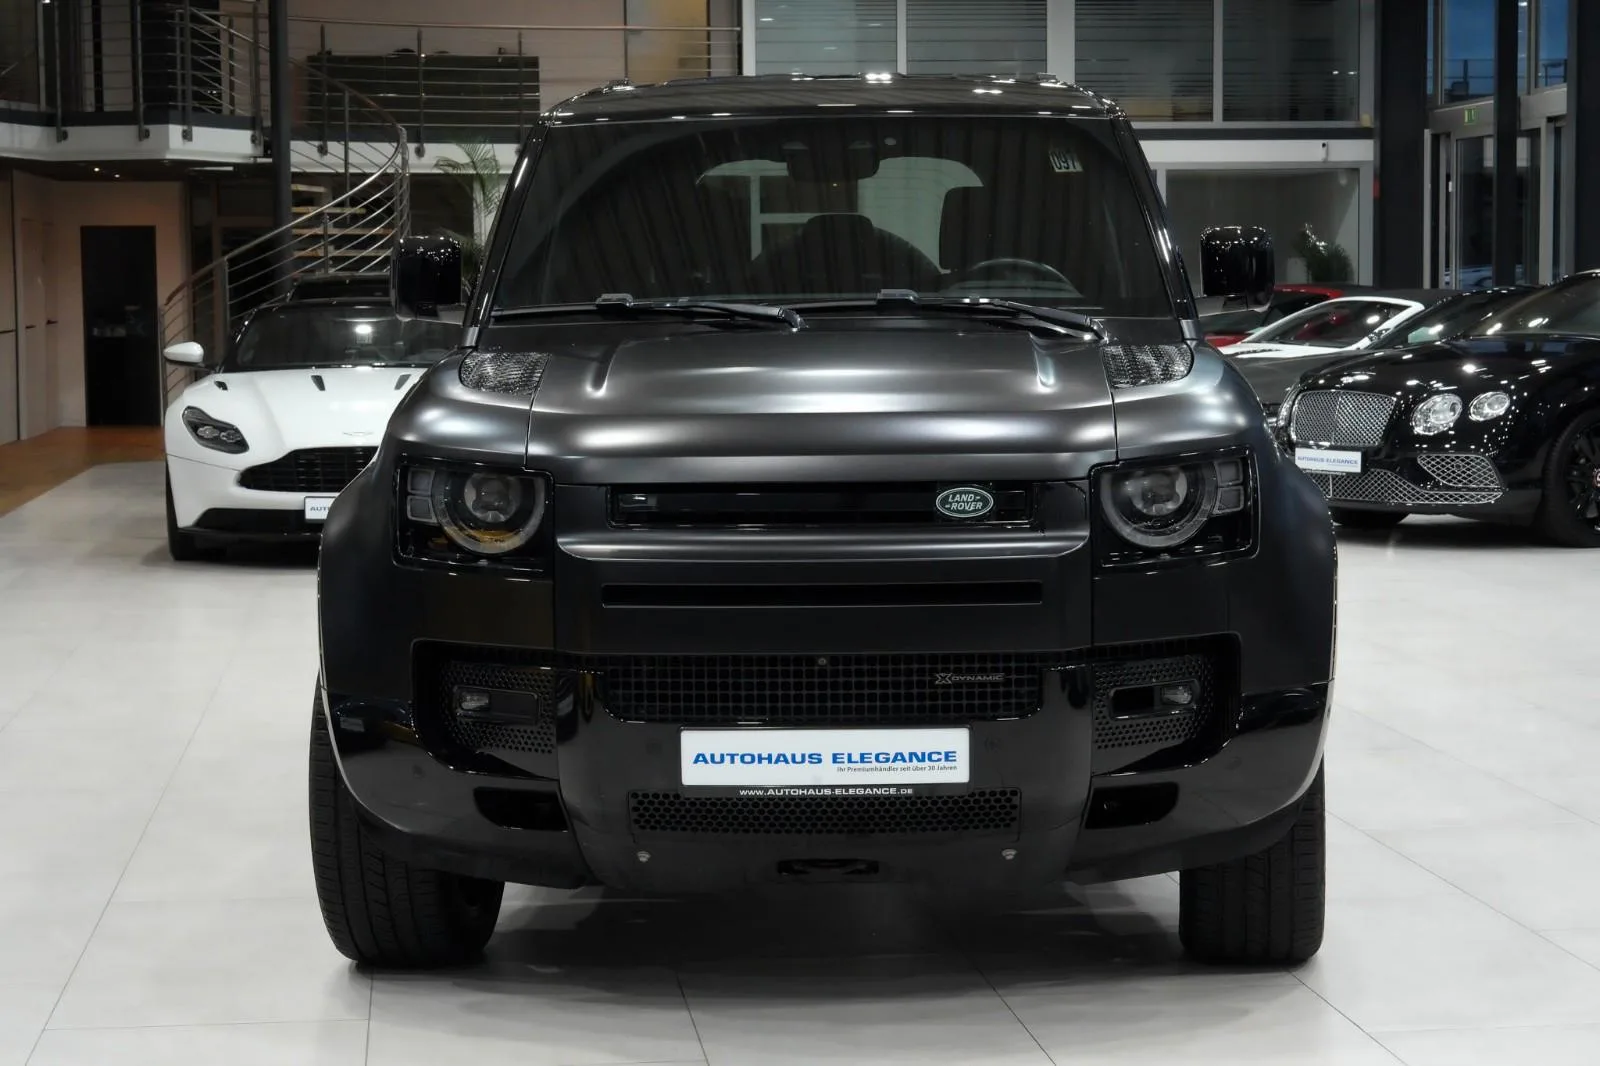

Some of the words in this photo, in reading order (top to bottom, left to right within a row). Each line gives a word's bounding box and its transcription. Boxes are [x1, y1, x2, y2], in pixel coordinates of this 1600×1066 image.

[693, 753, 823, 764] AUTOHAUS
[831, 751, 957, 764] ELEGANCE
[739, 788, 913, 796] www.AUTOHAUS-ELEGANCE.DE
